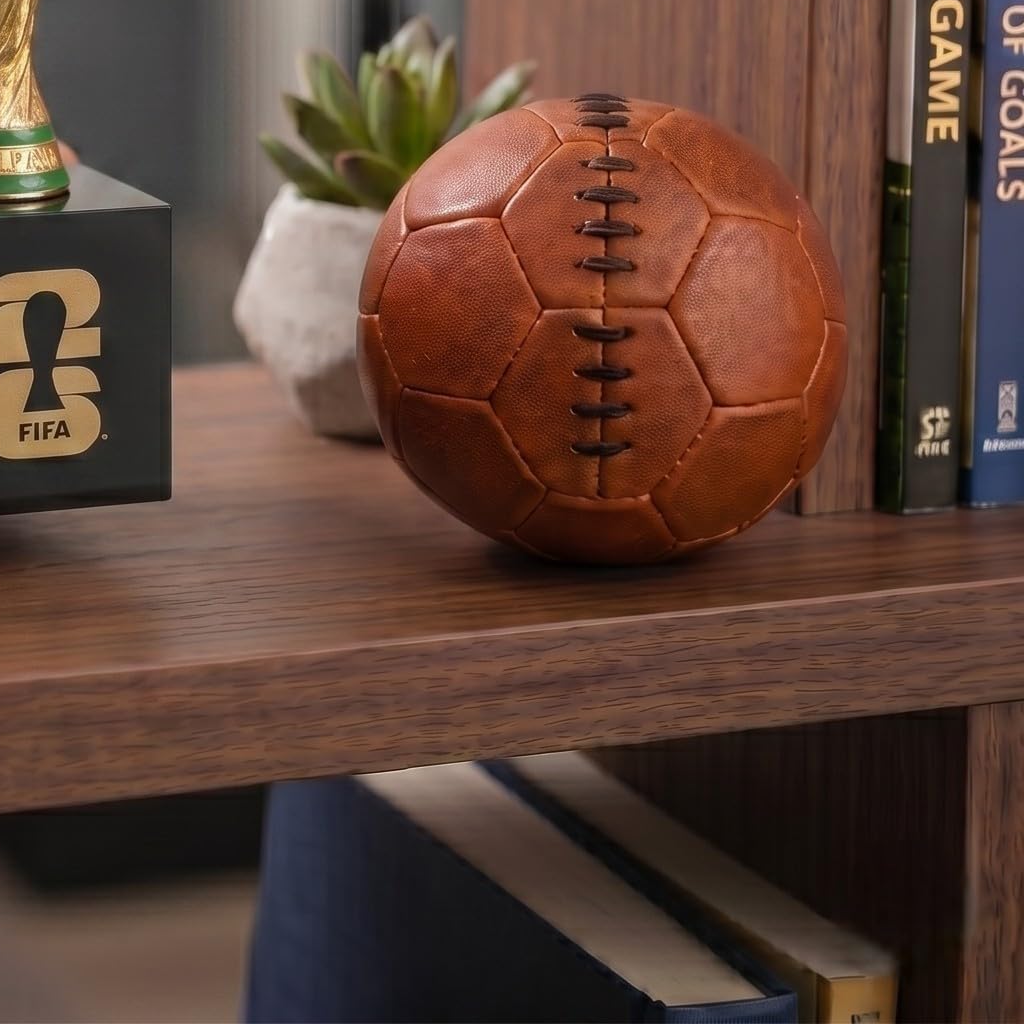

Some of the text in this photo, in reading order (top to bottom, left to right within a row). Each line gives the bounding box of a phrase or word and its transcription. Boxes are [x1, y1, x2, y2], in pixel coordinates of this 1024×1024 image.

[1001, 4, 1024, 56] OF
[996, 69, 1024, 203] GOALS
[18, 420, 71, 442] FIFA
